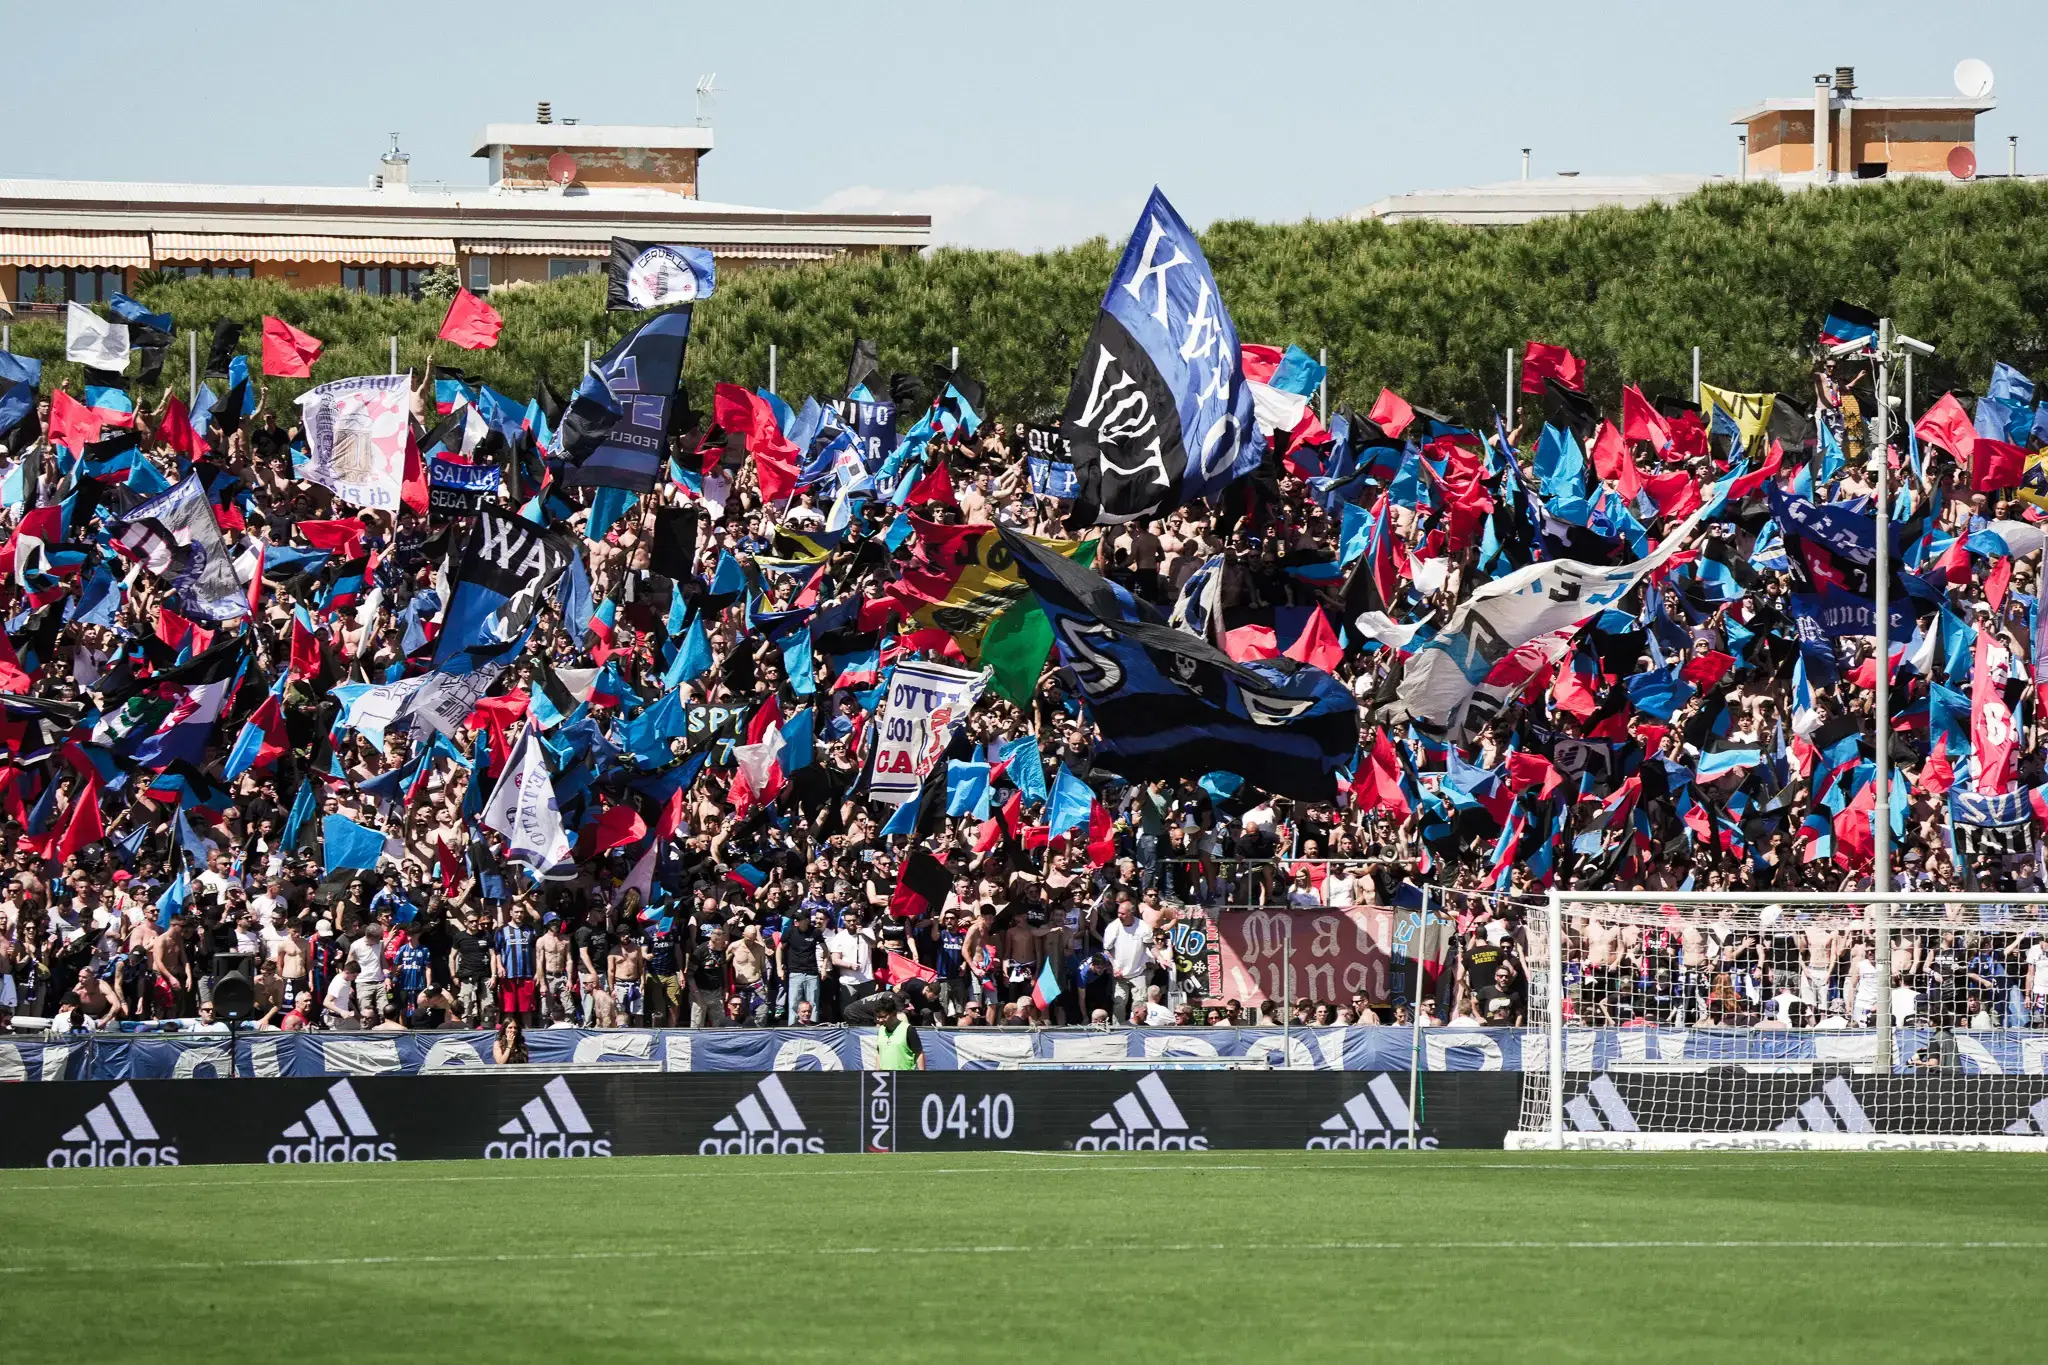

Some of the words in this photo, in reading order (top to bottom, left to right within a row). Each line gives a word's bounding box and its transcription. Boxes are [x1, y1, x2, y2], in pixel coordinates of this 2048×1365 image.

[832, 399, 889, 426] VIVO
[433, 464, 461, 482] SAI
[430, 490, 468, 510] SEGA
[688, 705, 750, 735] SPT
[1954, 822, 2034, 854] TATI
[868, 1071, 890, 1153] NGM
[921, 1093, 1015, 1140] 04:10
[267, 1136, 397, 1164] adidas
[484, 1133, 612, 1159] adidas
[699, 1130, 825, 1155] adidas
[1075, 1129, 1208, 1151] adidas
[1306, 1128, 1440, 1150] adidas
[47, 1139, 179, 1168] adidas
